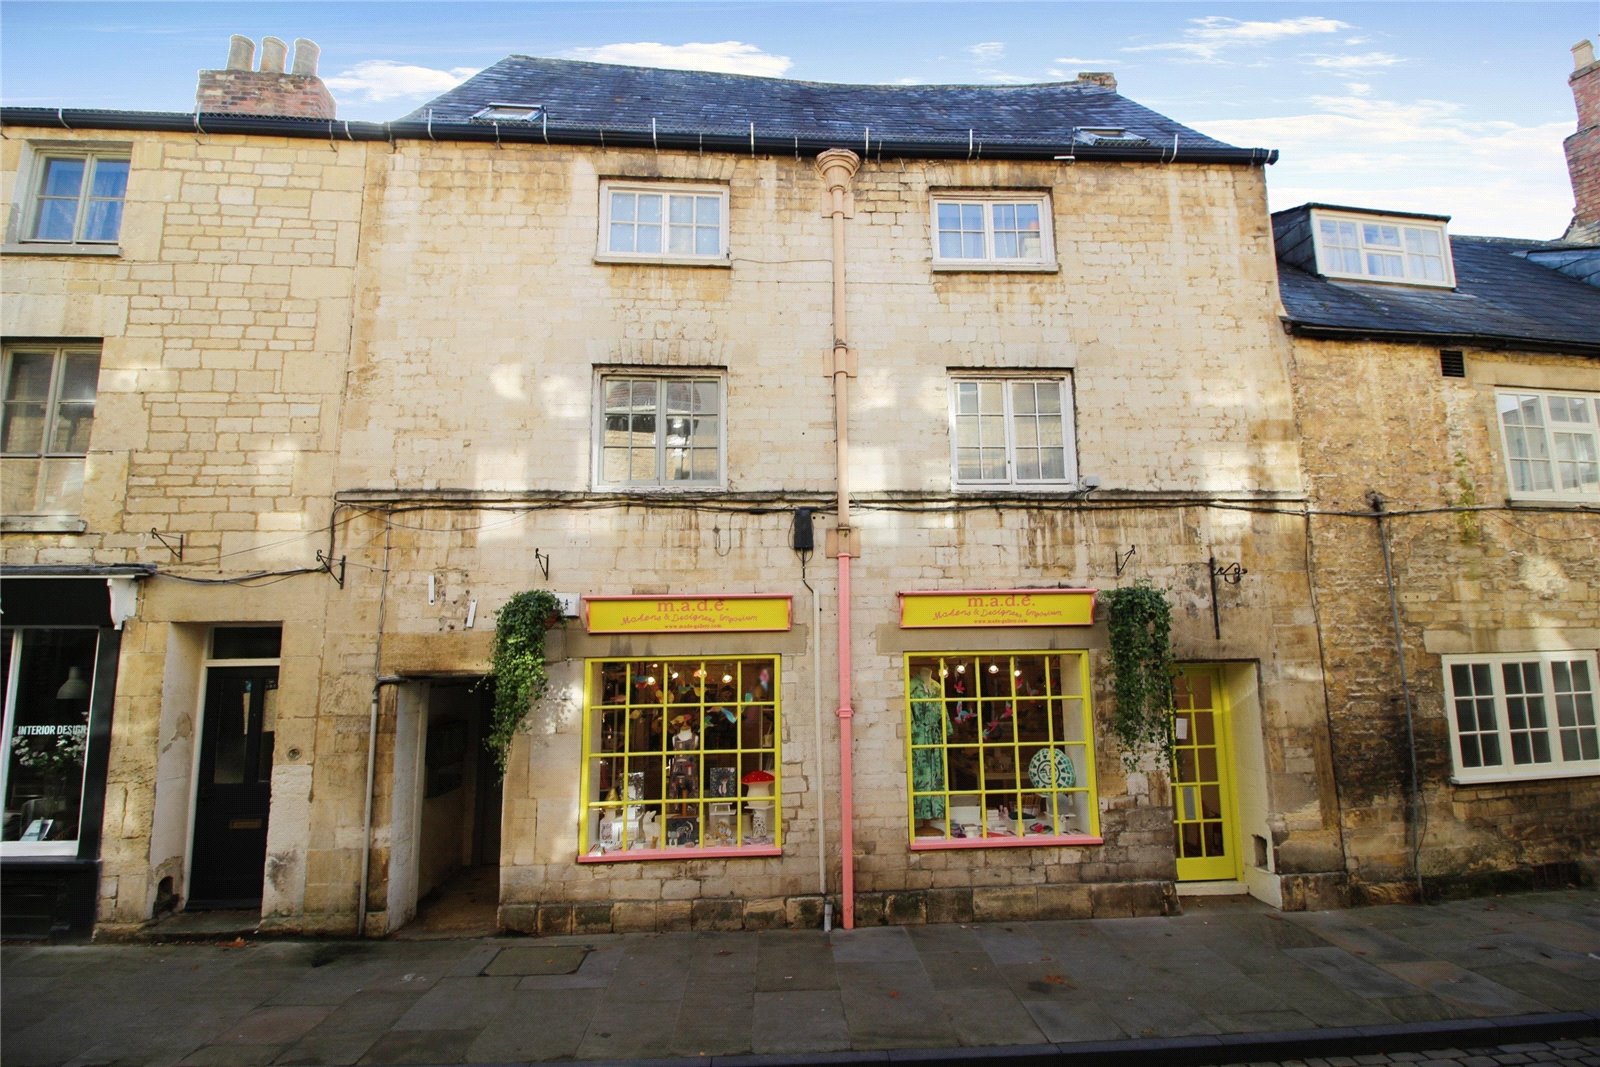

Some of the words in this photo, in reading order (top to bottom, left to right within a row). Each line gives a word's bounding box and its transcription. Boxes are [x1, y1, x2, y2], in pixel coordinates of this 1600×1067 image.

[657, 598, 729, 612] m.a.d.e.
[967, 594, 1036, 607] m.a.d.e.
[17, 725, 55, 735] INTERIOR
[56, 725, 87, 736] DESIGN
